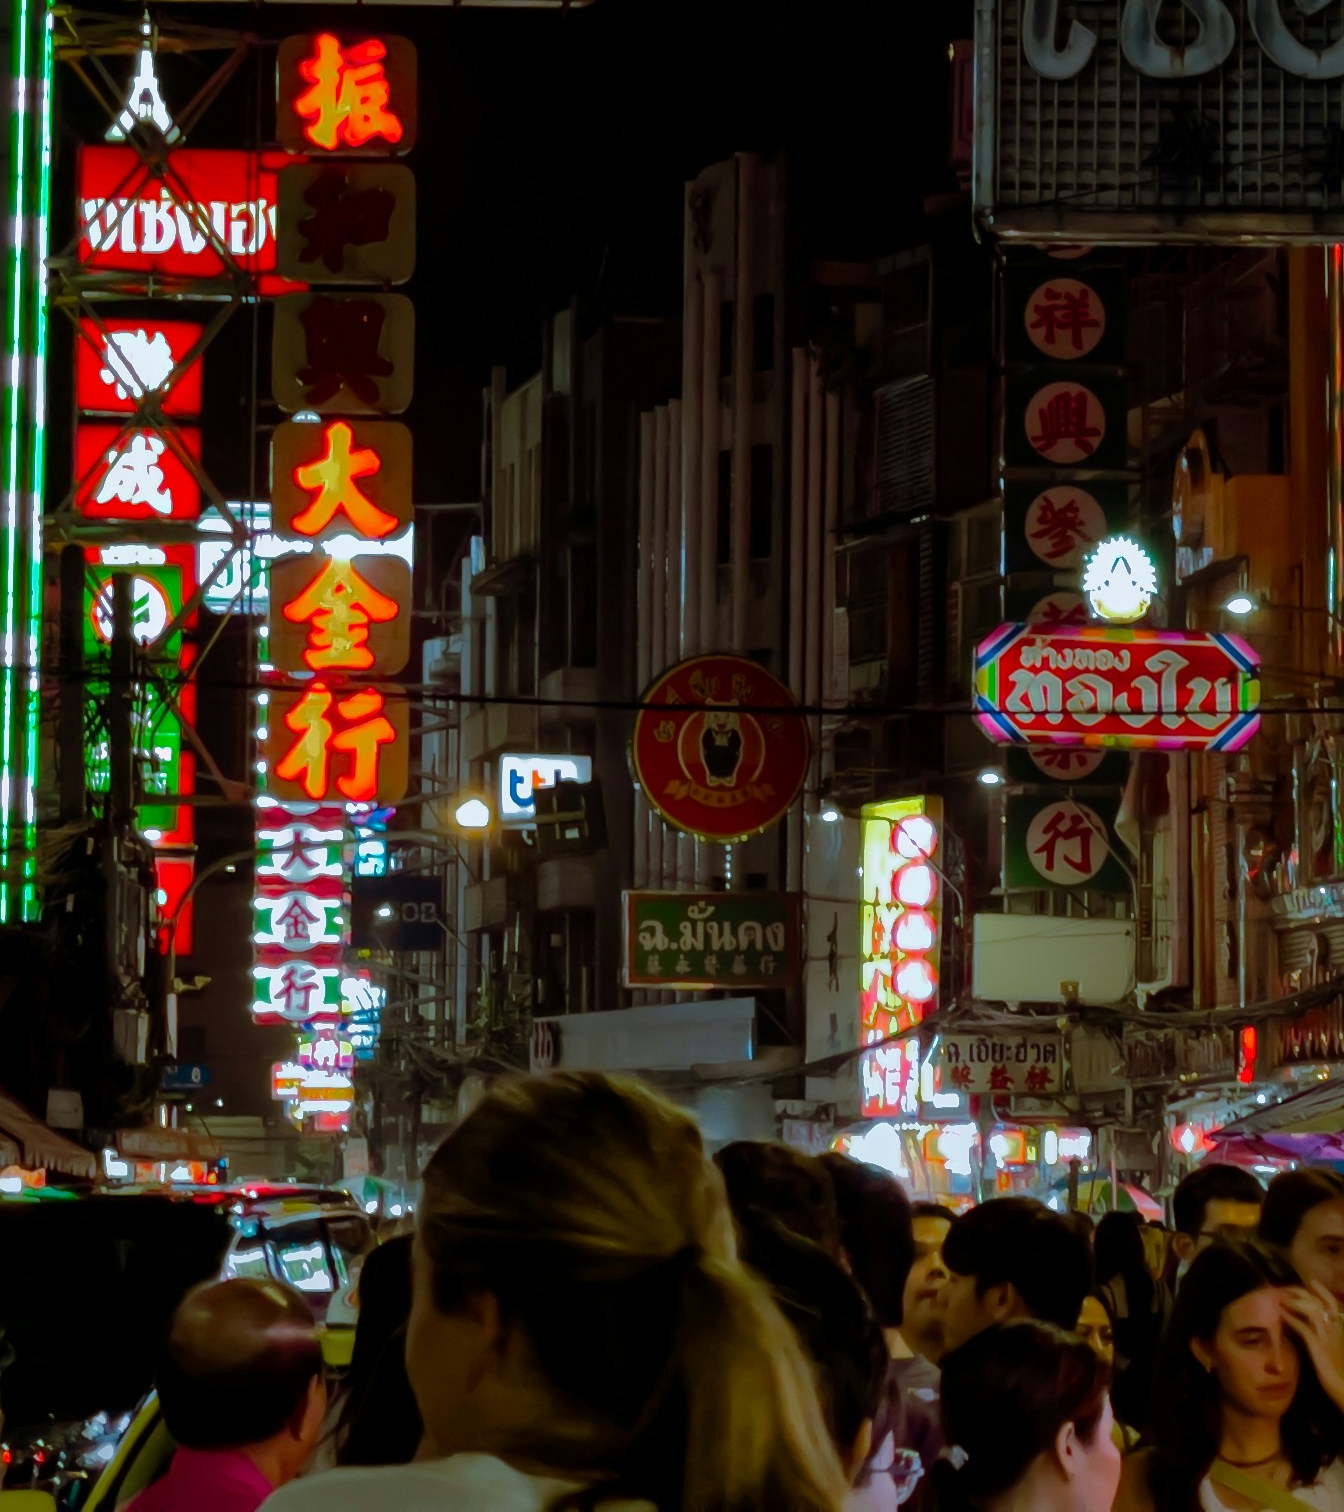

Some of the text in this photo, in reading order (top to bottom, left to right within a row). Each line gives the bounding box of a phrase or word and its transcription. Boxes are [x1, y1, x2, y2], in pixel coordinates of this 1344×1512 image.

[273, 830, 321, 1012] 大金行
[638, 900, 786, 952] ฉ.มั่นคง
